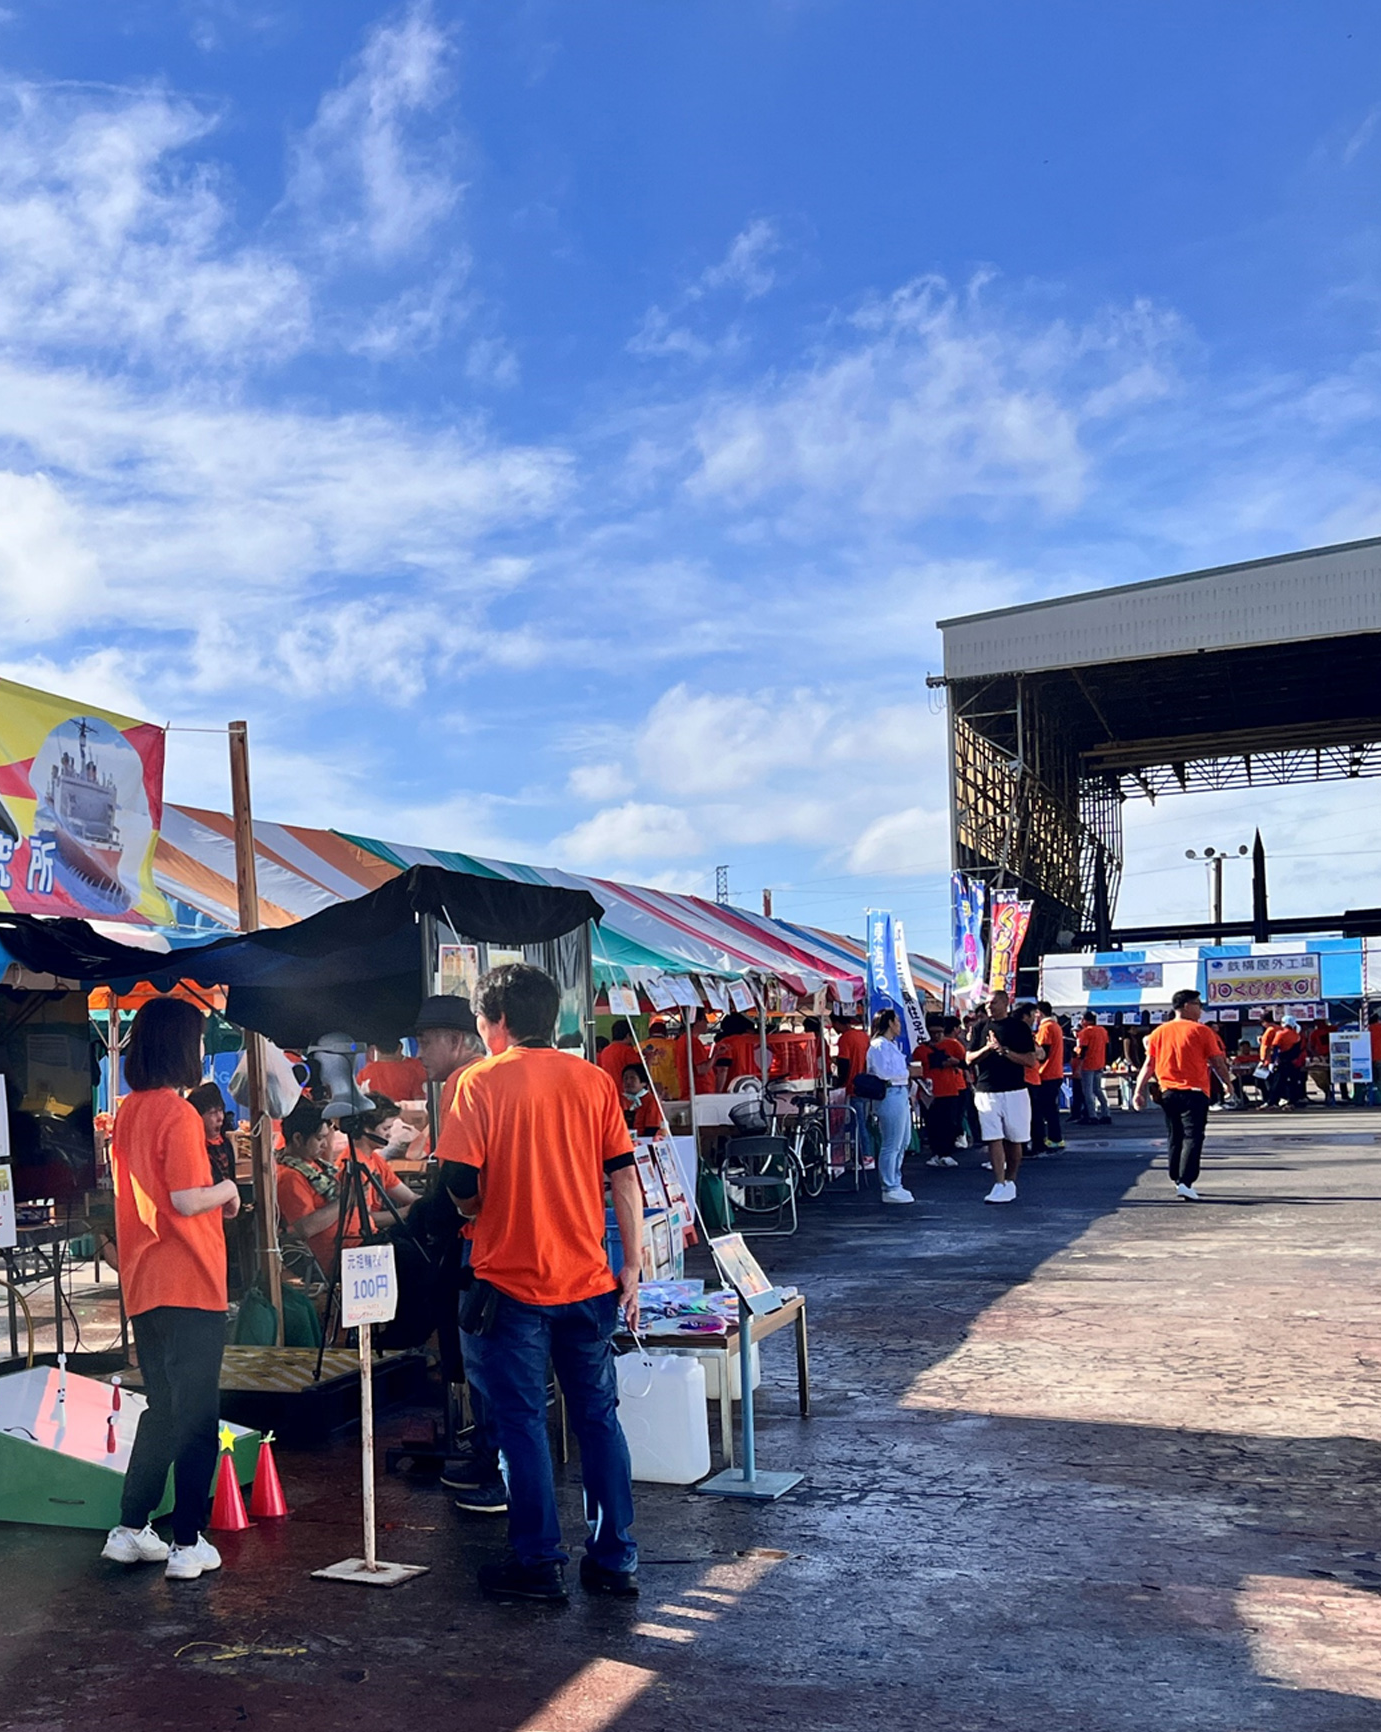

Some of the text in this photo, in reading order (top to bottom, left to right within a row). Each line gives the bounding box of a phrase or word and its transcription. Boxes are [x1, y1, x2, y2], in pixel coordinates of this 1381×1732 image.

[1234, 979, 1294, 997] くじびき
[354, 1275, 387, 1299] 100円
